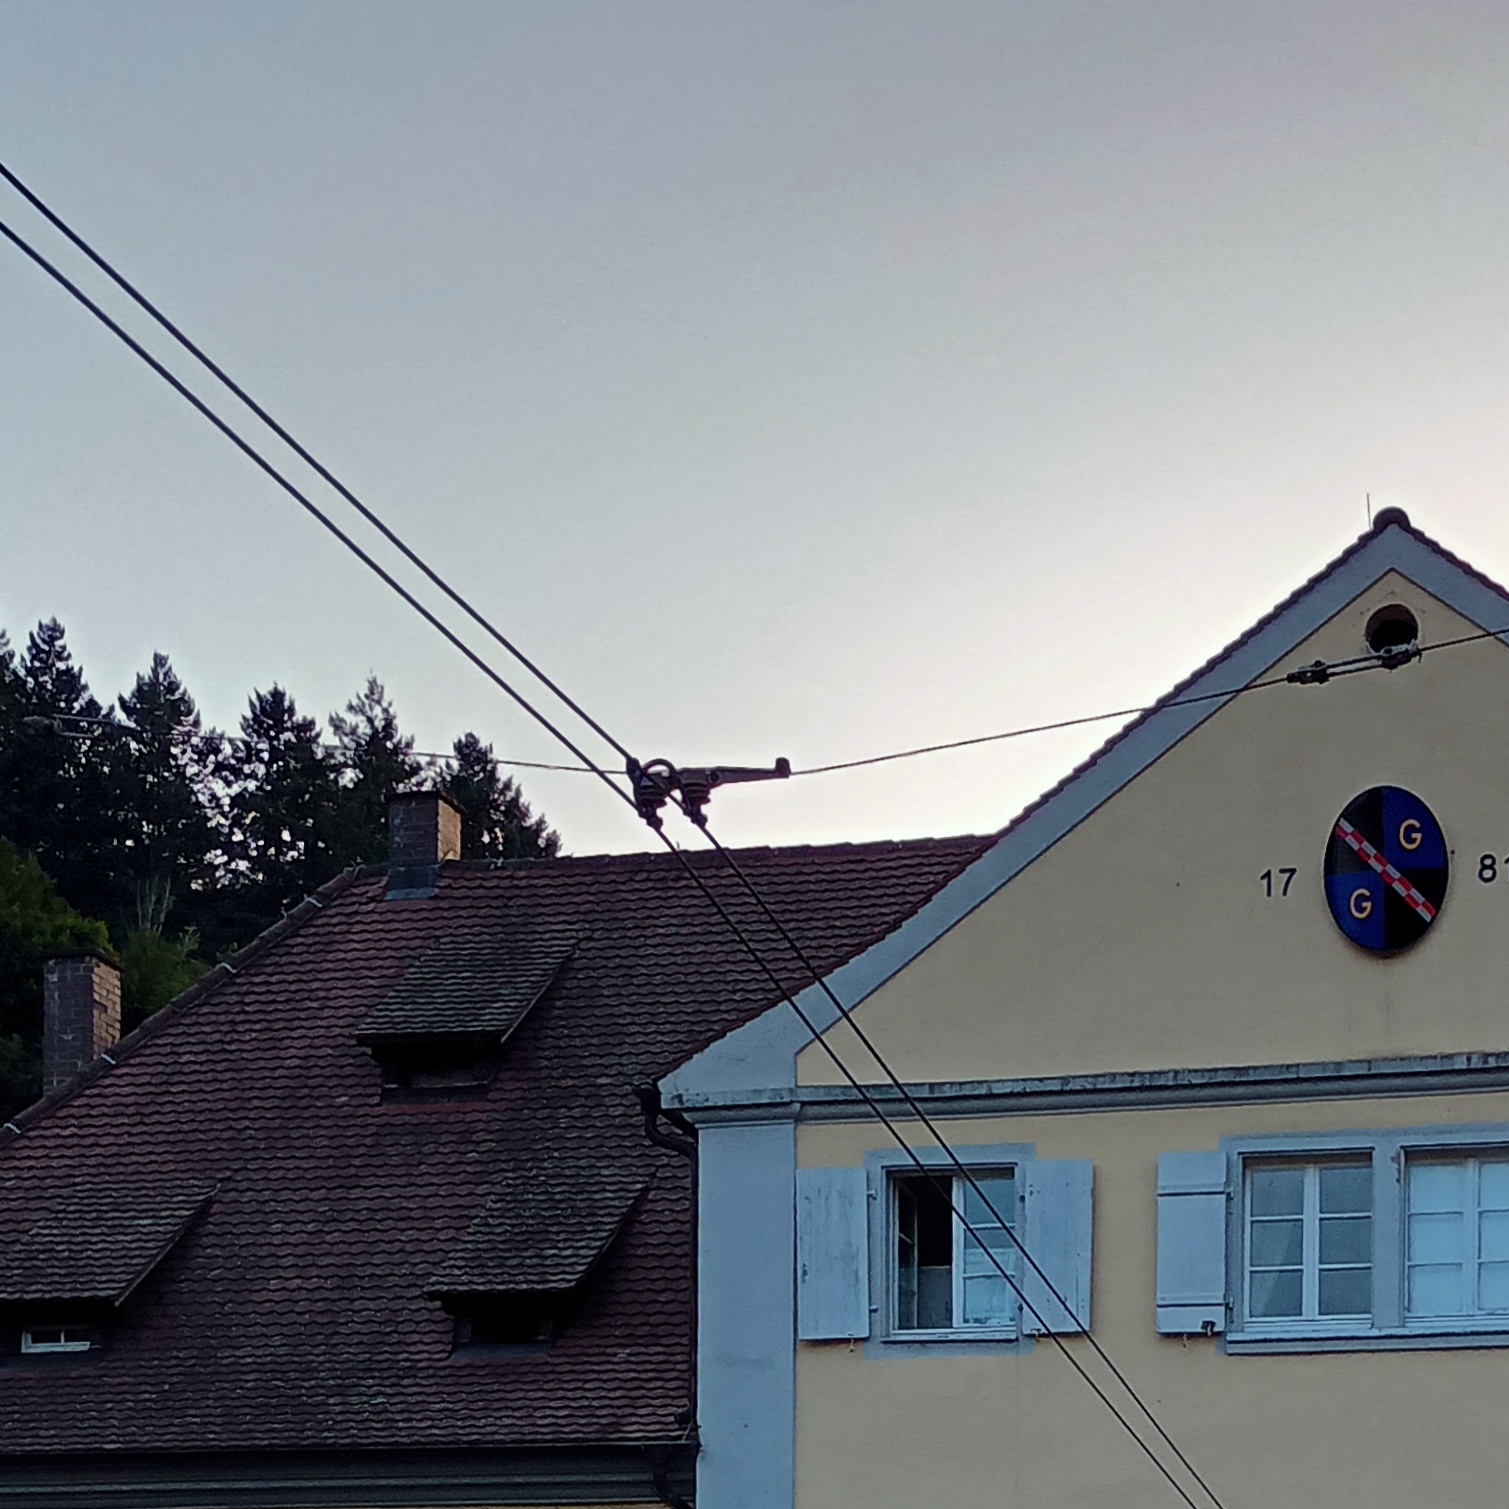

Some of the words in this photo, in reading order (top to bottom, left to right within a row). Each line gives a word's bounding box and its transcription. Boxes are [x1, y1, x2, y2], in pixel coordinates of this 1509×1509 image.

[1399, 819, 1422, 850] G
[1260, 868, 1297, 897] 17
[1350, 888, 1373, 919] G
